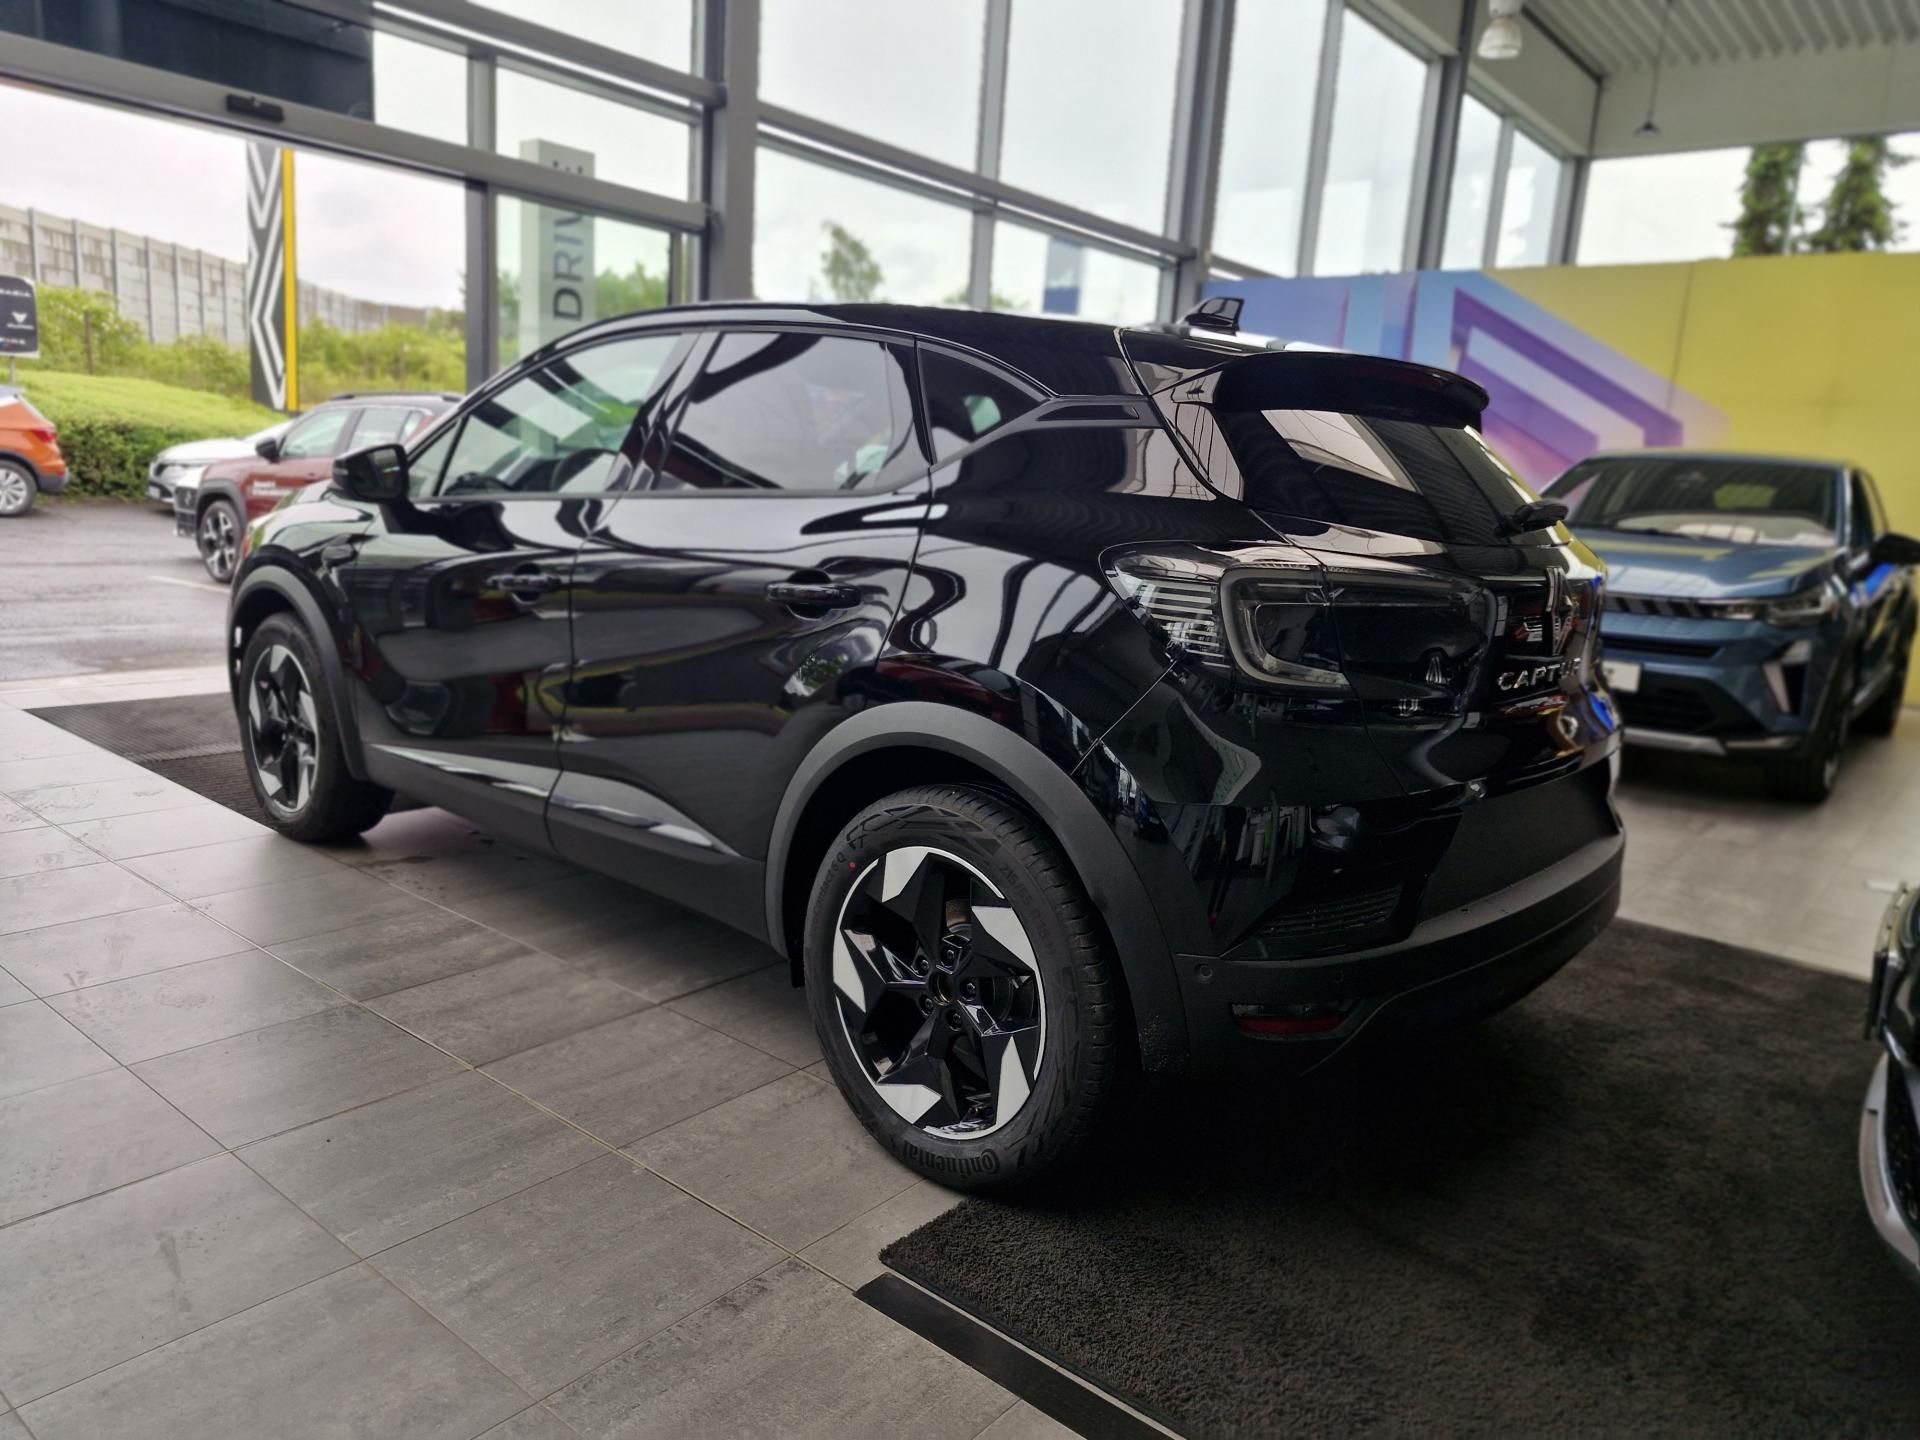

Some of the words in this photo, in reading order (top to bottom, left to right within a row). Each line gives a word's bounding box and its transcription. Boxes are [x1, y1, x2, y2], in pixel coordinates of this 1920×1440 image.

[553, 160, 583, 321] DRIV
[1497, 657, 1581, 691] CAPTUR
[902, 1141, 999, 1178] Continental
